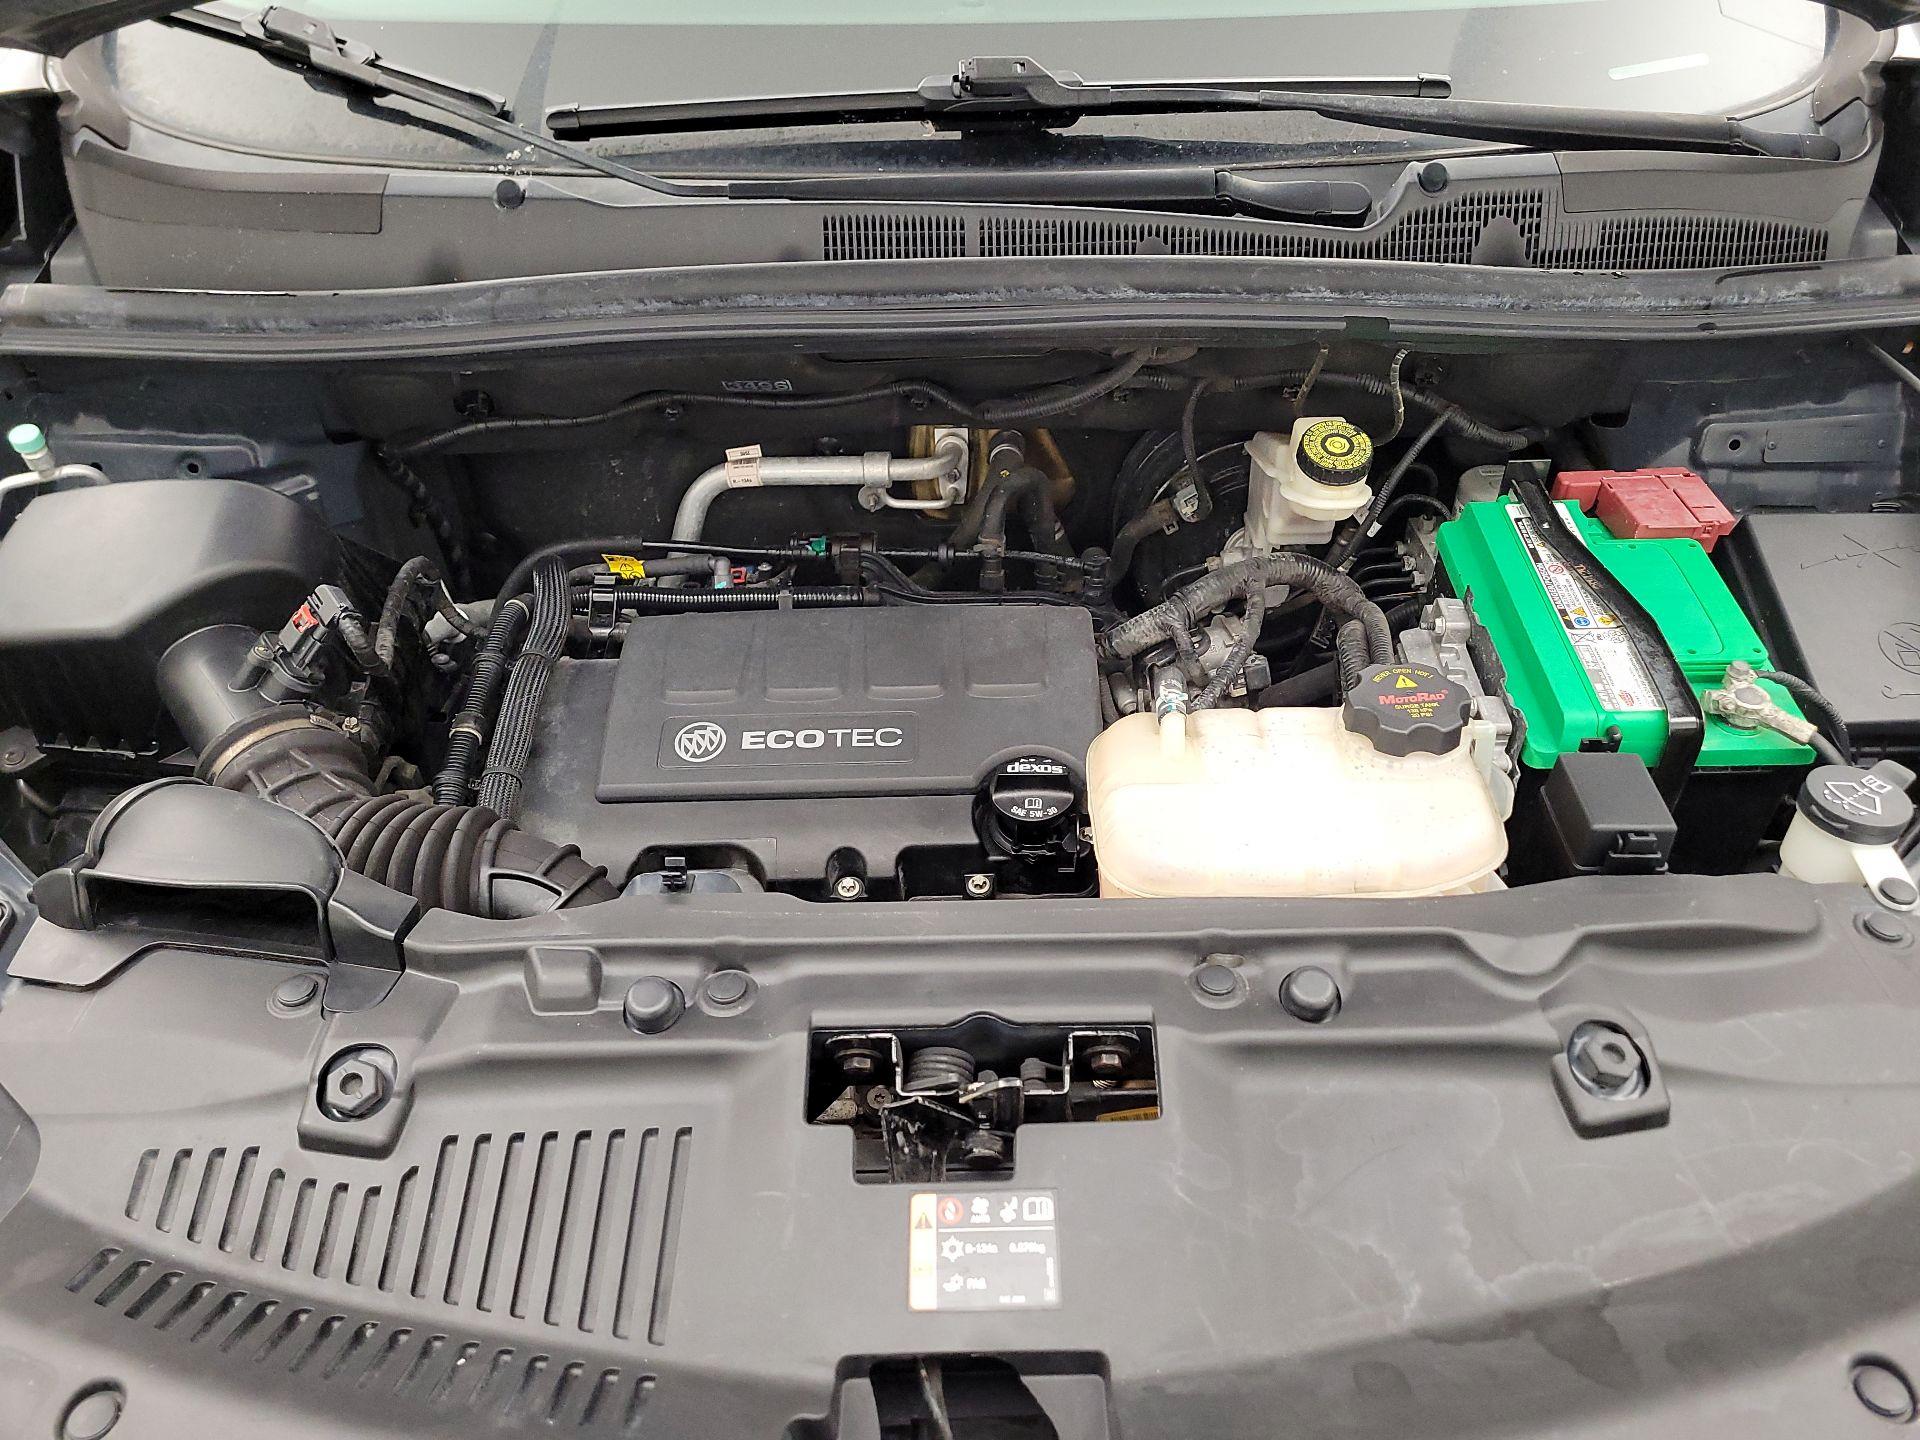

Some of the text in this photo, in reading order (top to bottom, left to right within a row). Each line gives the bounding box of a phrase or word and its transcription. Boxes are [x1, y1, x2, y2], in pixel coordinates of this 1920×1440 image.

[741, 727, 903, 750] ECOTEC
[1006, 761, 1063, 774] dexos
[1010, 805, 1058, 818] SAE 5W-30
